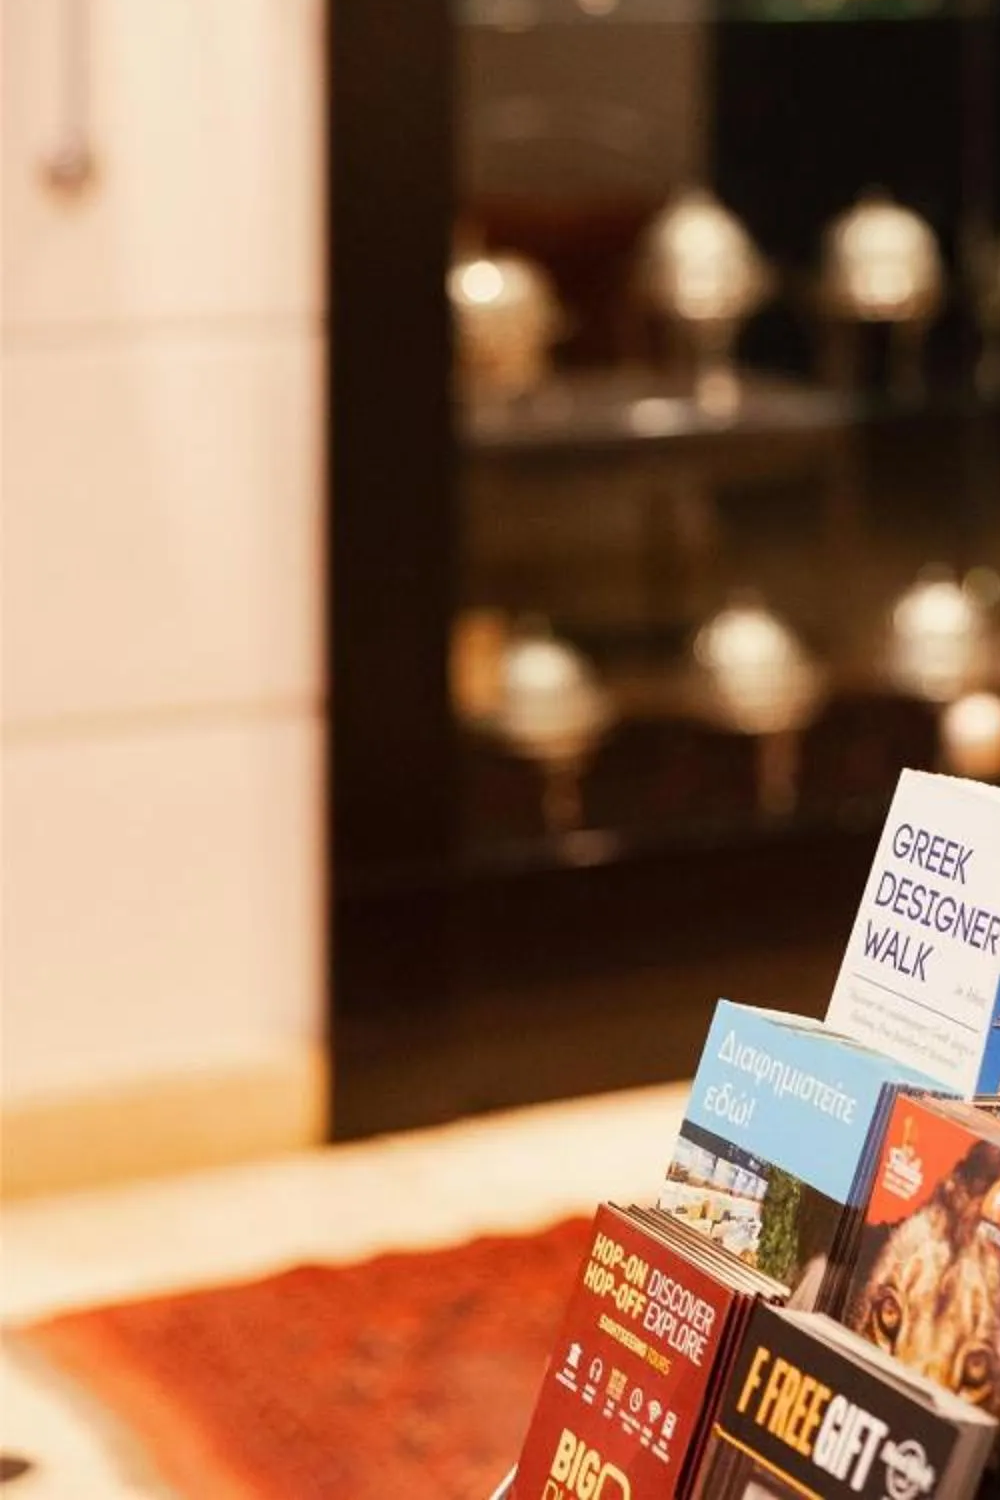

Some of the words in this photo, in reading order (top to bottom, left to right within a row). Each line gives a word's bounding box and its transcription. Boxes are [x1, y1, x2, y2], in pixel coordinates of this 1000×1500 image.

[892, 823, 975, 885] GREEK
[864, 919, 935, 982] WALK
[703, 1082, 756, 1127] εδώ!
[717, 1029, 858, 1126] Διαφημιστείτε
[583, 1259, 648, 1320] HOP-OFF
[643, 1301, 709, 1367] EXPLORE
[591, 1231, 650, 1290] HOP-ON
[647, 1268, 716, 1338] DISCOVER
[550, 1427, 602, 1500] BIG
[754, 1357, 835, 1457] FREE
[812, 1393, 891, 1493] GIFT
